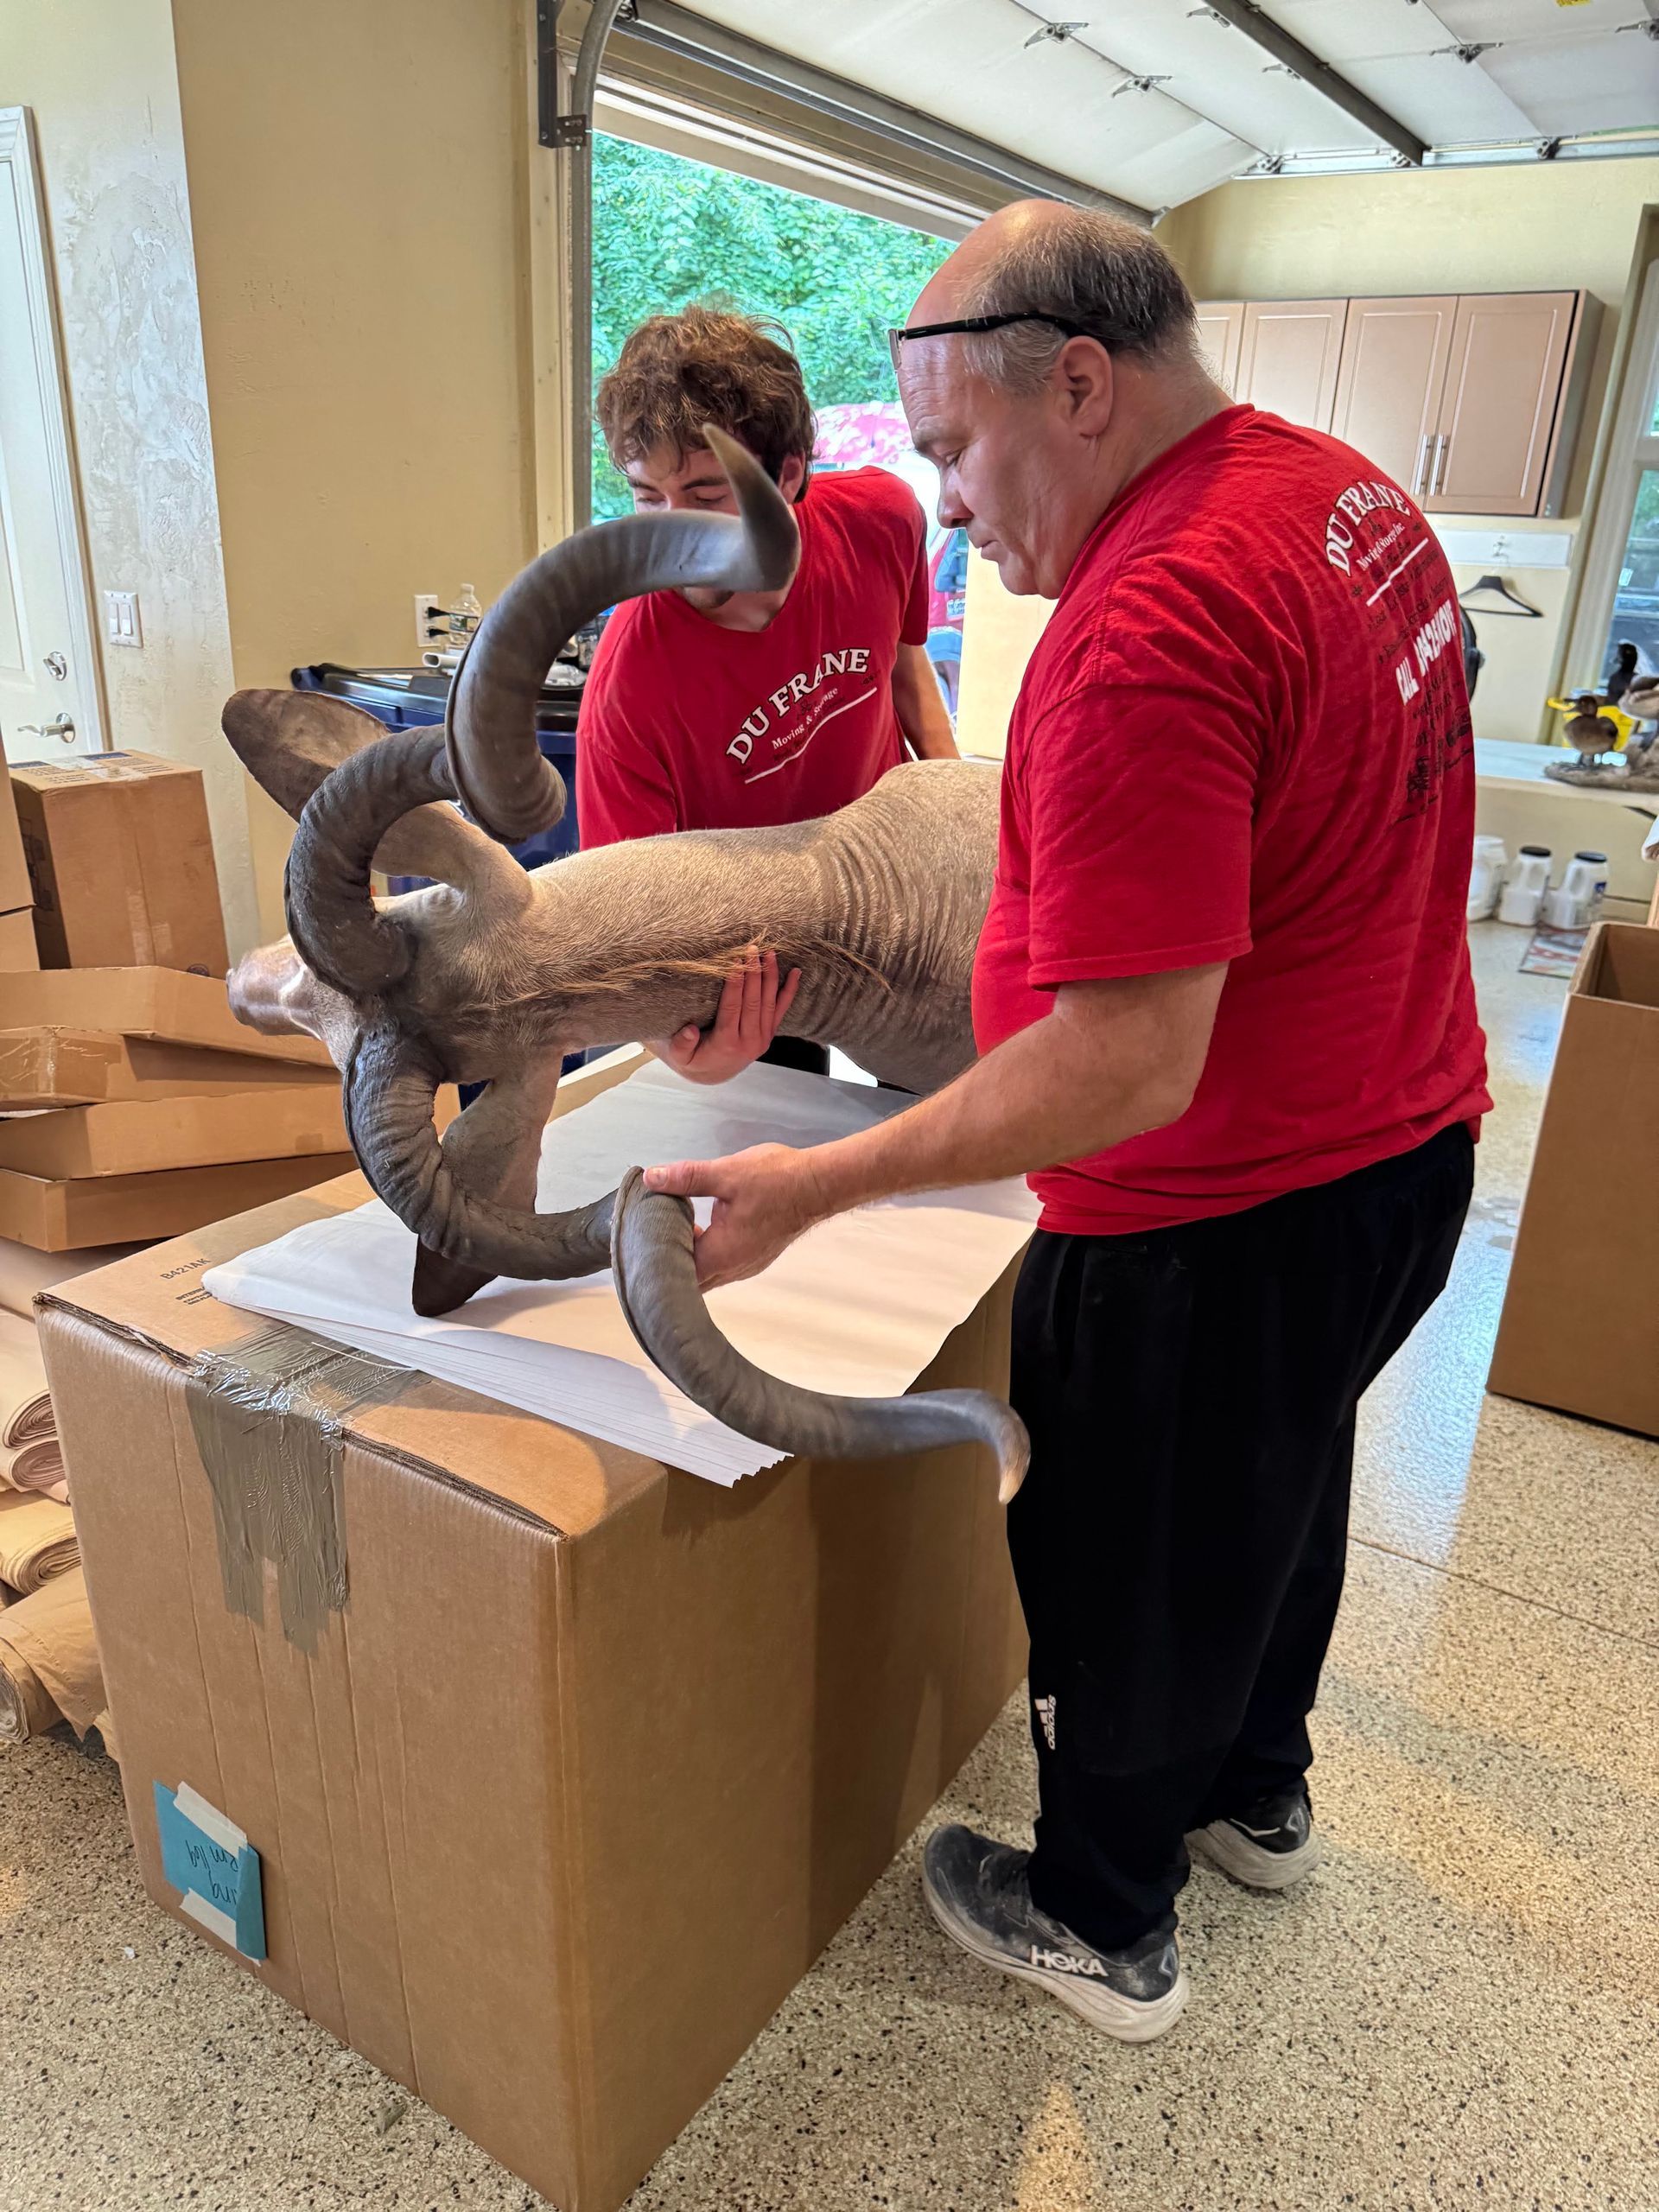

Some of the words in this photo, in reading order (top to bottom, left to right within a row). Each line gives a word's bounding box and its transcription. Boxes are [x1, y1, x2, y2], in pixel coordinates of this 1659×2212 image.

[1335, 481, 1411, 526] FRANE
[1325, 512, 1354, 577] DU
[726, 706, 771, 765] DU
[768, 648, 871, 717] FRANE
[772, 723, 804, 750] Moving
[805, 715, 813, 725] &
[159, 1257, 212, 1280] B421AK
[1047, 1694, 1057, 1751] adidas
[1030, 1944, 1109, 1977] HOKA
